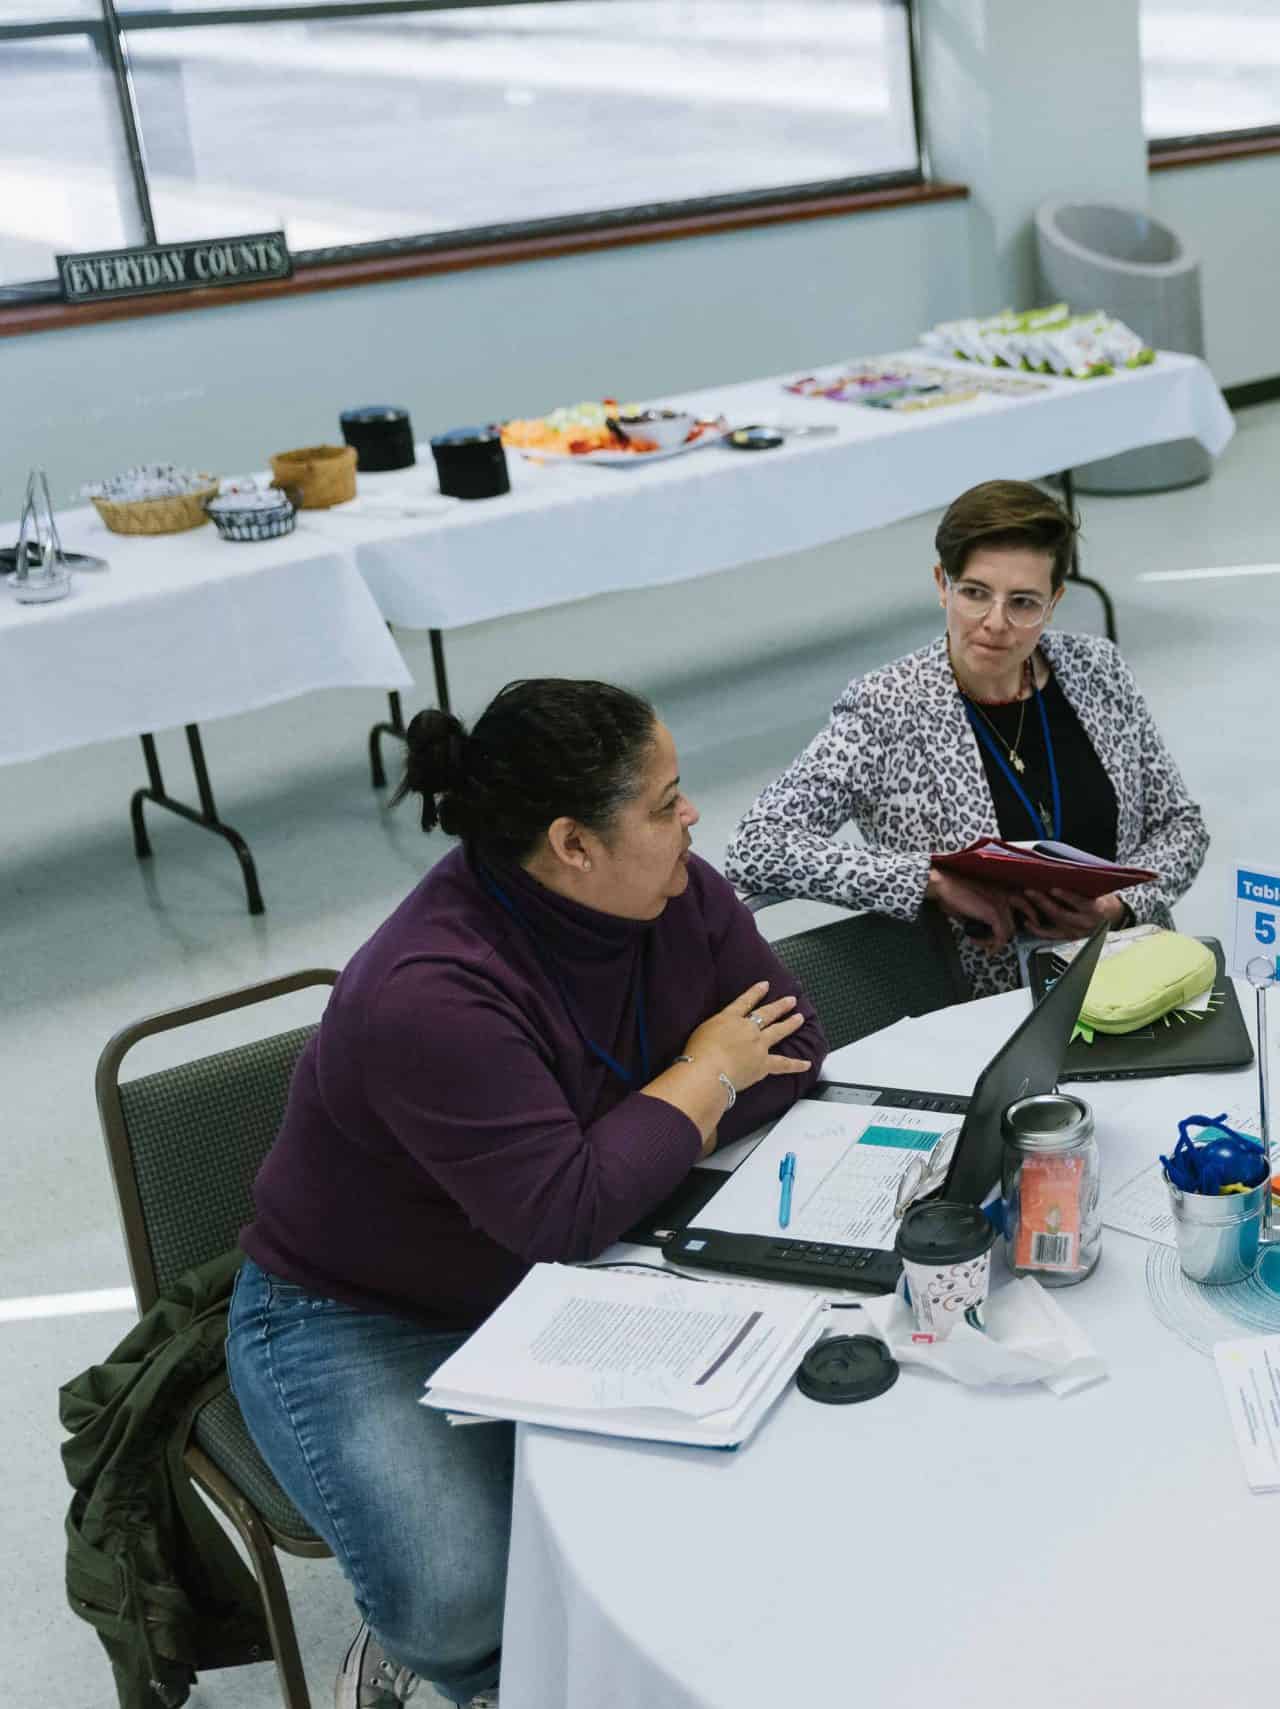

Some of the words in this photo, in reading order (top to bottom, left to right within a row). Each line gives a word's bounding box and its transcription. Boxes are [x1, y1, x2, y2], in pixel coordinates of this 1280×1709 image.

[71, 251, 187, 294] EVERYDAY
[194, 242, 282, 278] COUNTS
[1255, 911, 1276, 945] 5
